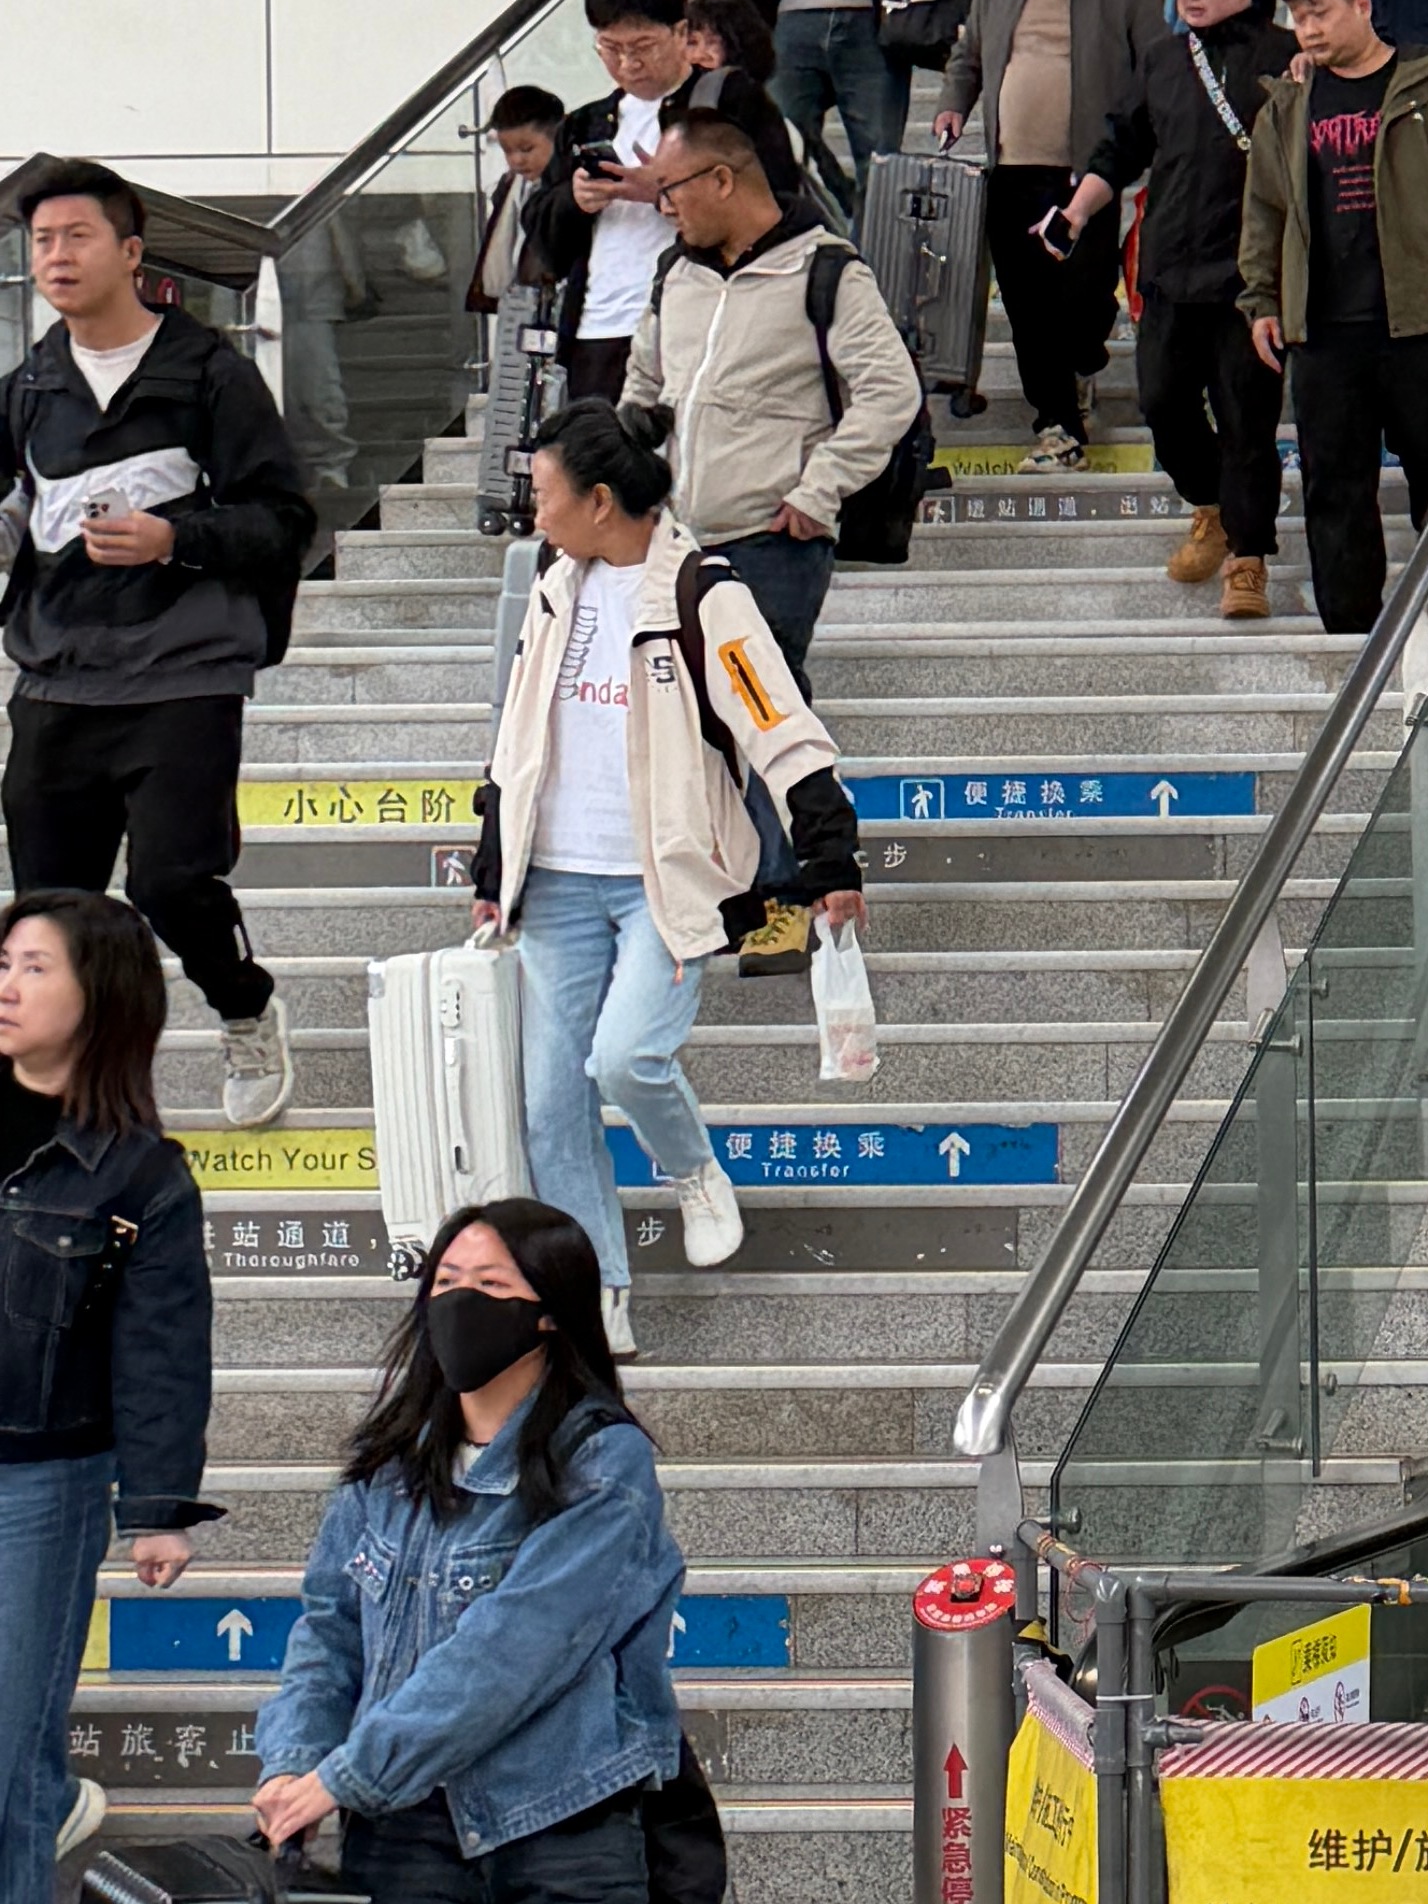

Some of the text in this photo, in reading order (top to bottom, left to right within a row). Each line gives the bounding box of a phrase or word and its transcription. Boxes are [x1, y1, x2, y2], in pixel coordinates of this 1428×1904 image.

[283, 785, 456, 824] 小心台阶
[963, 778, 1104, 805] 便捷换乘
[726, 1131, 885, 1160] 便捷换乘
[283, 1147, 349, 1172] Your
[761, 1162, 850, 1178] Transfer
